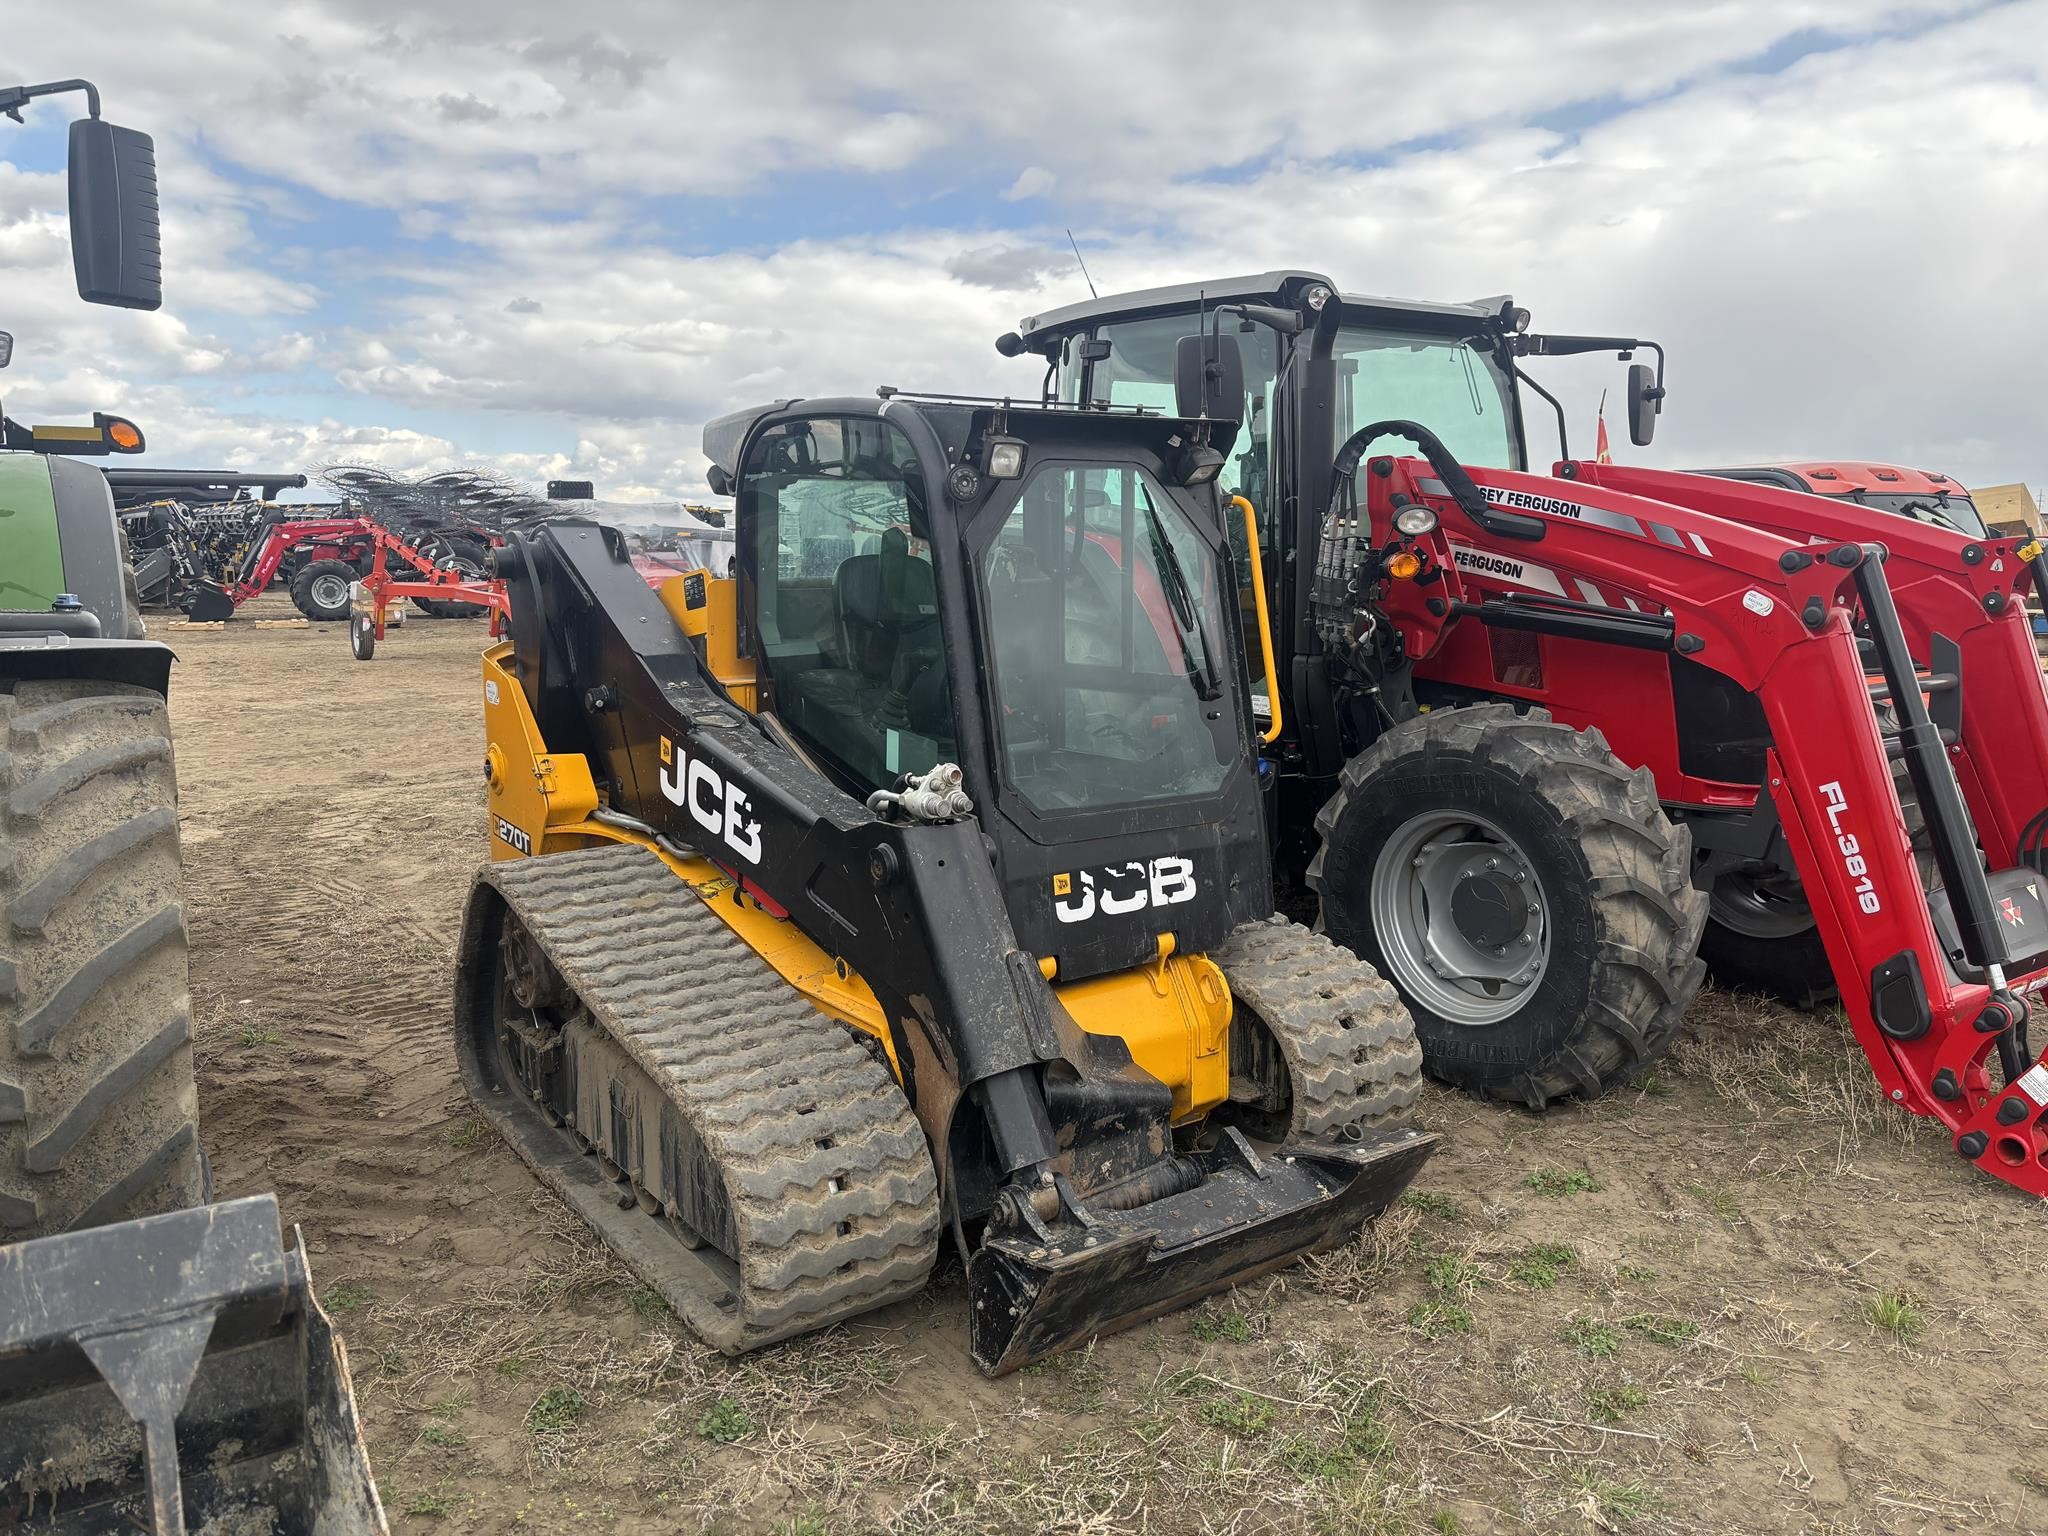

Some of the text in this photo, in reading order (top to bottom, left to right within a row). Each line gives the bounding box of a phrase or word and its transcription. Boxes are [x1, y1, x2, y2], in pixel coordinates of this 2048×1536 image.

[1479, 487, 1581, 519] SEY FERGUSON
[1454, 551, 1523, 579] FERGUSON
[660, 746, 762, 865] JCB
[500, 819, 530, 854] 270T
[1818, 781, 1881, 914] FL.3819
[1055, 855, 1197, 924] JCB
